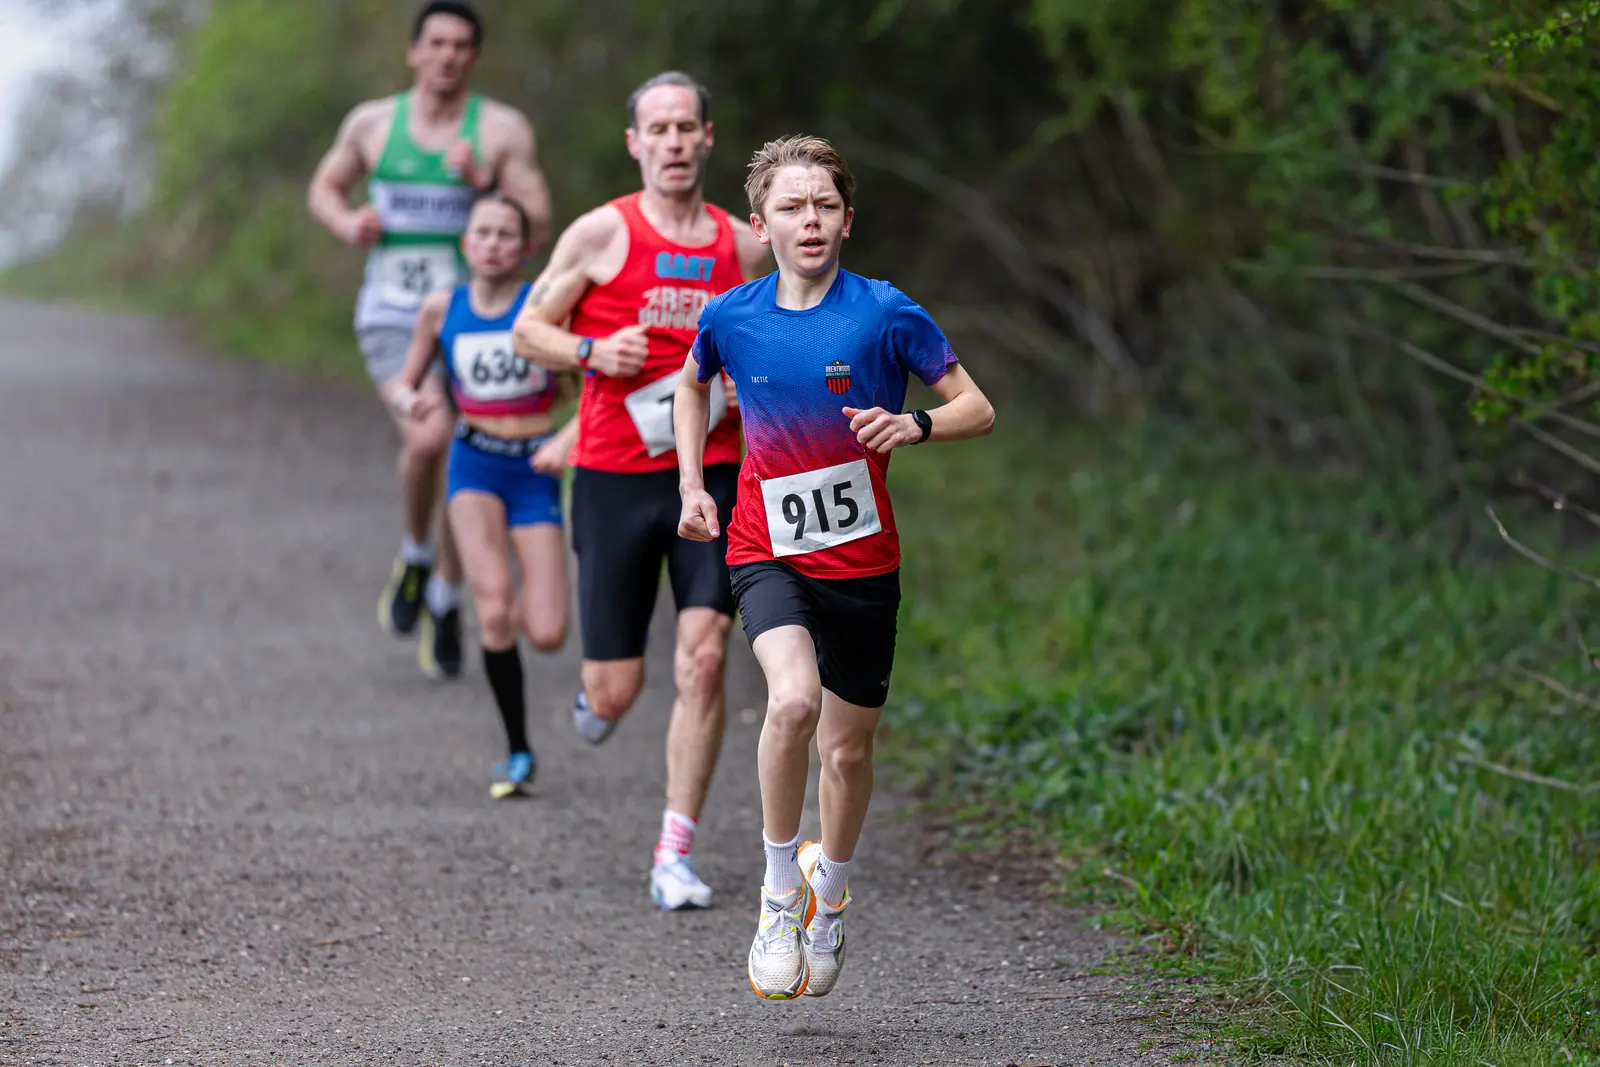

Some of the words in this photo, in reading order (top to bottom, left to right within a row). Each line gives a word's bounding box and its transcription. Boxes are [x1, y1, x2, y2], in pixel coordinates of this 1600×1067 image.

[655, 252, 716, 282] GARY
[471, 349, 530, 386] 630
[781, 480, 859, 541] 915
